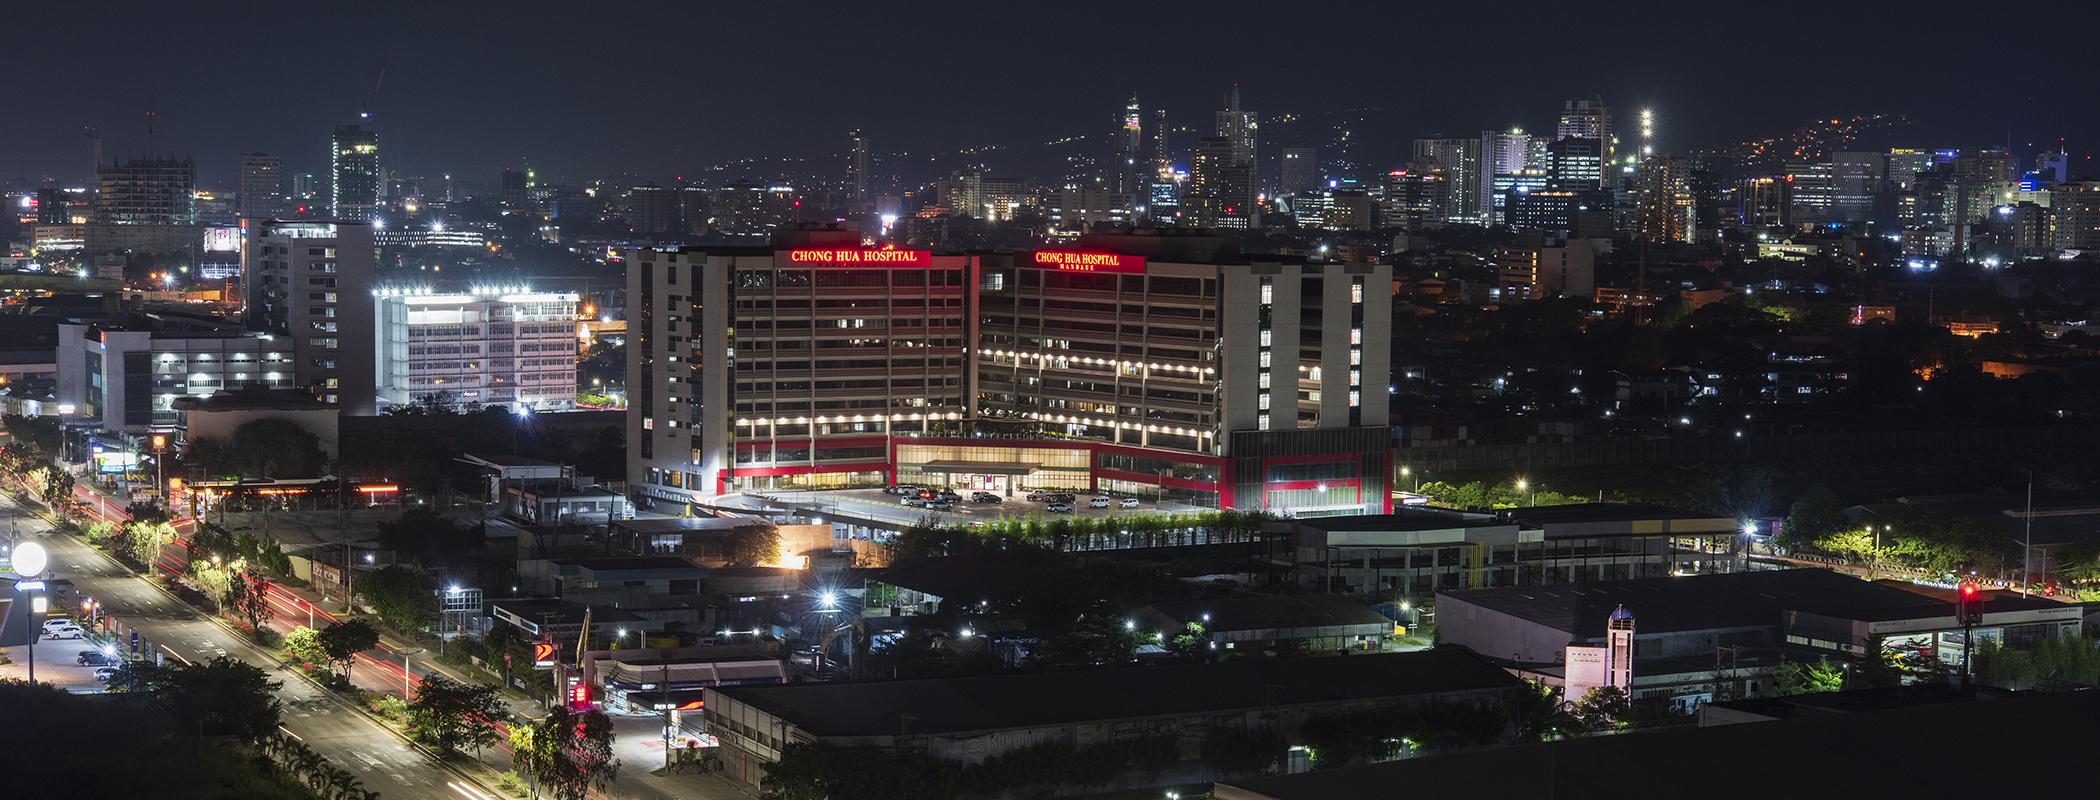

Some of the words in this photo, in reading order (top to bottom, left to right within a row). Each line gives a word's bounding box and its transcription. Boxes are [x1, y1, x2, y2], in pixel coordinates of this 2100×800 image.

[792, 251, 832, 261] CHONG
[836, 251, 860, 261] HUA
[864, 251, 917, 261] HOSPITAL
[1035, 252, 1063, 263] CHONG
[1065, 253, 1081, 263] HUA
[1082, 254, 1119, 265] HOSPITAL
[1060, 263, 1094, 271] MANDAUE
